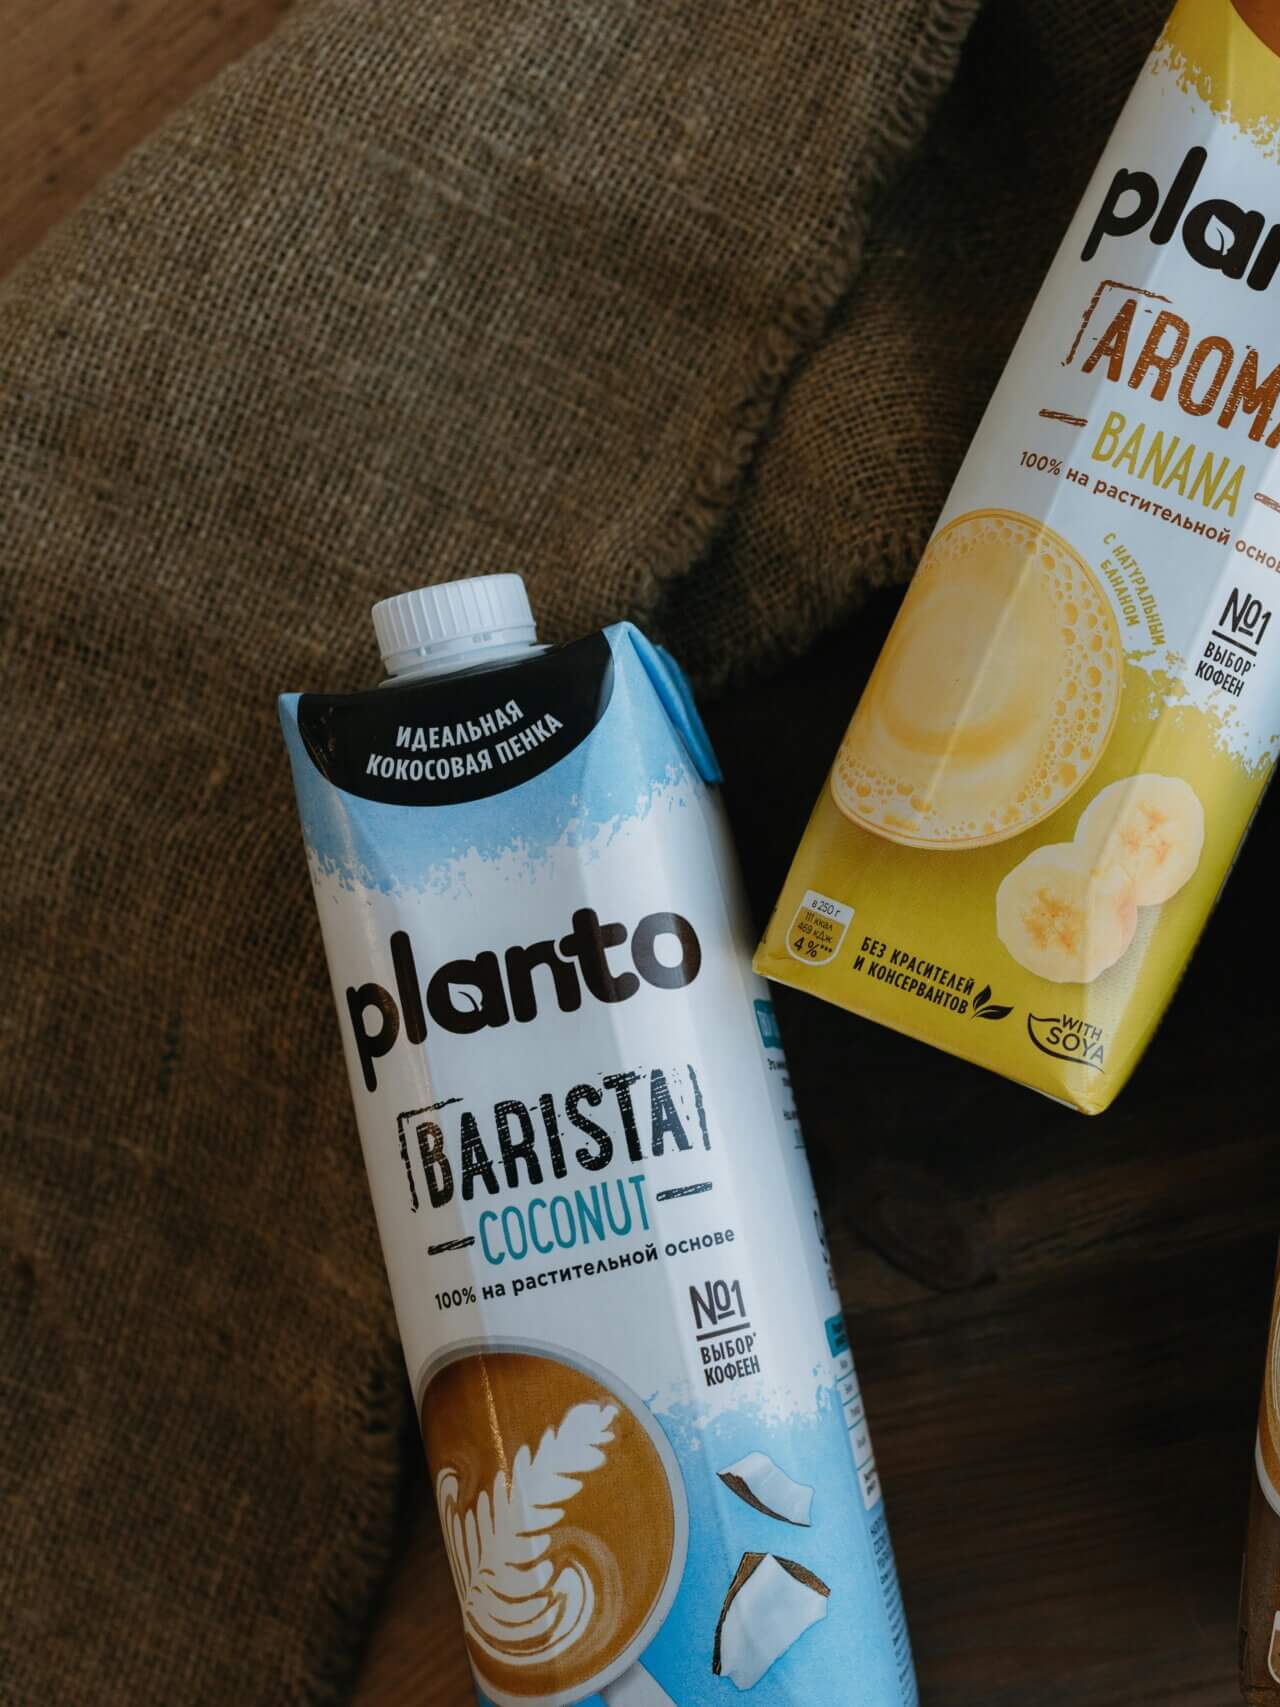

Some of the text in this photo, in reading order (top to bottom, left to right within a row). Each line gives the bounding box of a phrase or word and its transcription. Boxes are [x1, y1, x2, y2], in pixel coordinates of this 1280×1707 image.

[1019, 451, 1062, 476] 100%
[1065, 466, 1089, 486] на
[1093, 478, 1231, 546] растительной
[1091, 411, 1247, 518] BANANA
[1100, 559, 1140, 627] БАНАНОМ
[1103, 532, 1166, 646] С НАТУРАЛЬНЫМ
[1194, 660, 1245, 698] КОФЕЕН
[366, 712, 564, 782] КОКОСОВАЯ ПЕНКА
[396, 699, 524, 753] ИДЕАЛЬНАЯ
[817, 901, 834, 915] 250
[346, 907, 701, 1092] planto
[853, 955, 969, 1015] И КОНСЕРВАНТОВ
[861, 936, 976, 995] БЕЗ КРАСИТЕЛЕЙ
[1046, 1026, 1105, 1064] SOYA
[1061, 1013, 1103, 1041] WITH
[416, 1068, 693, 1208] BARISTA
[478, 1174, 650, 1266] COCONUT
[434, 1228, 736, 1310] 100% на растительной основе
[703, 1355, 761, 1387] КОФЕЕН
